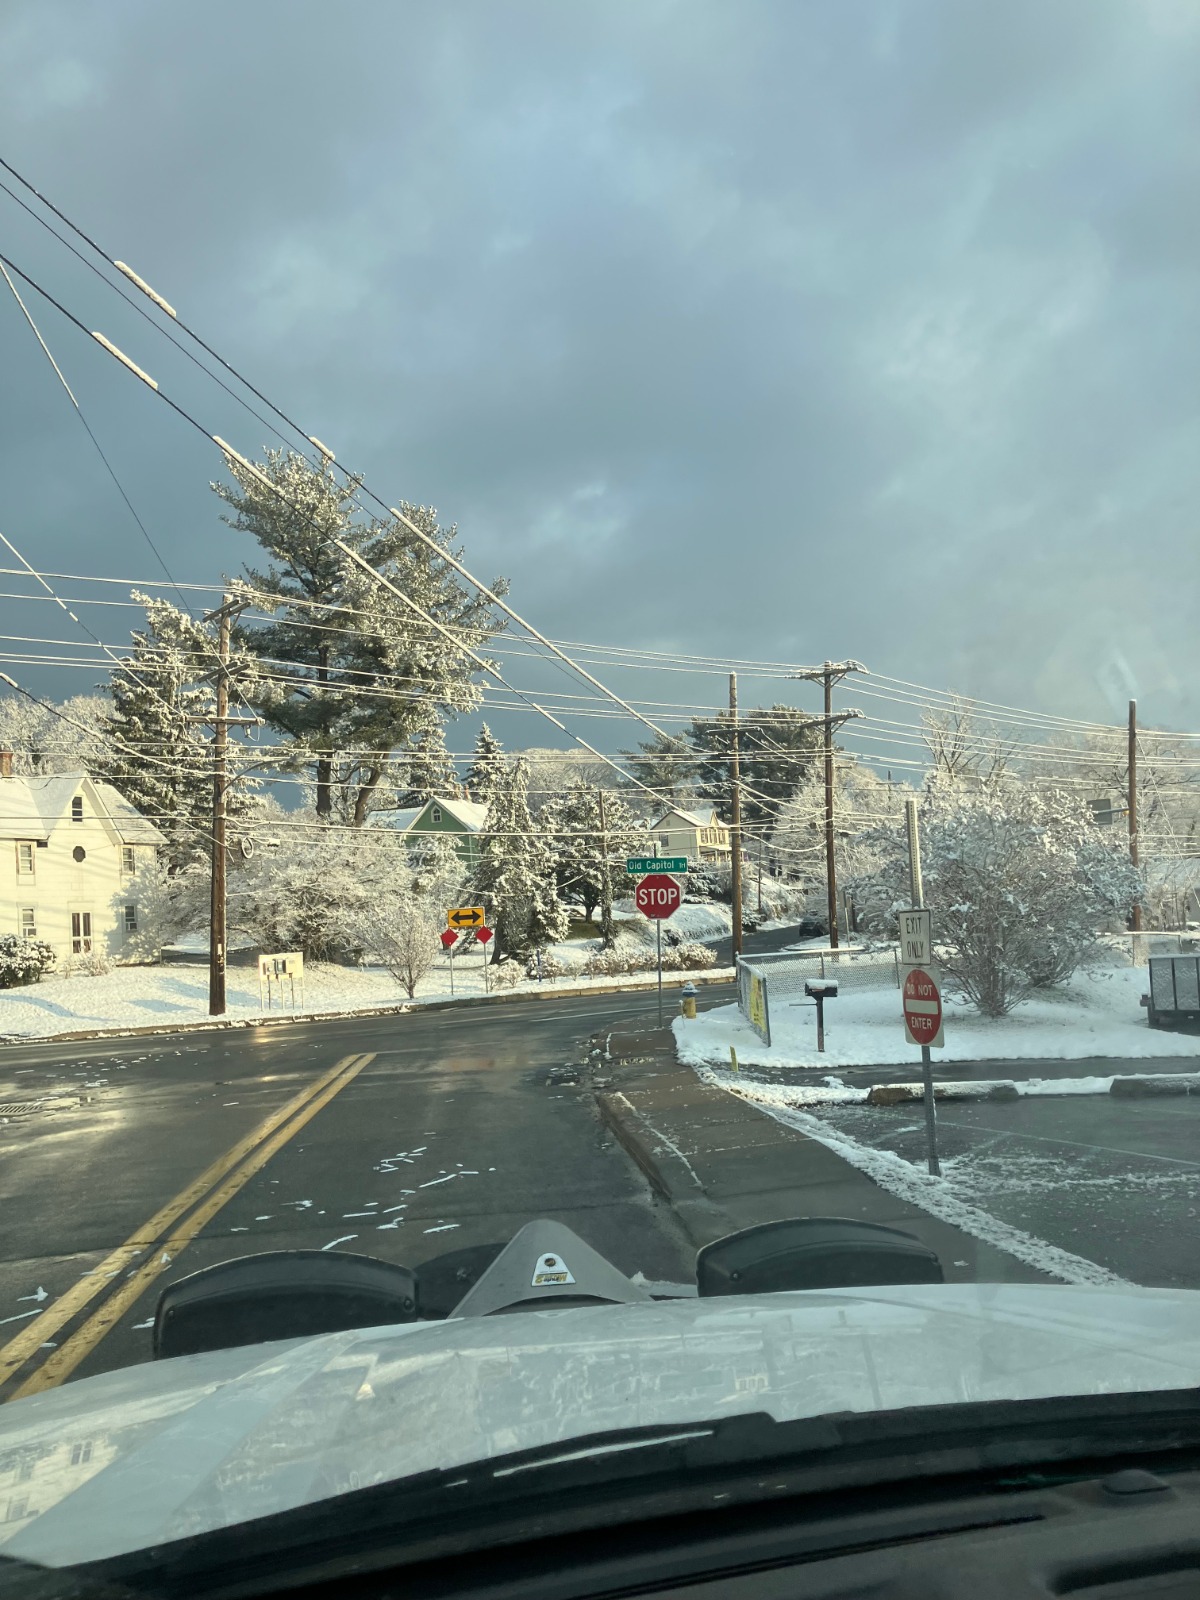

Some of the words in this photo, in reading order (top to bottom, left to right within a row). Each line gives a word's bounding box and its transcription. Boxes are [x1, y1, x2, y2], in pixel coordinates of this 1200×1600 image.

[628, 861, 642, 870] Old
[646, 860, 674, 870] Capitol
[638, 888, 678, 905] STOP
[905, 916, 922, 934] EXIT
[906, 940, 924, 958] ONLY
[906, 983, 915, 995] DO
[917, 984, 933, 996] NOT
[911, 1016, 933, 1030] ENTER
